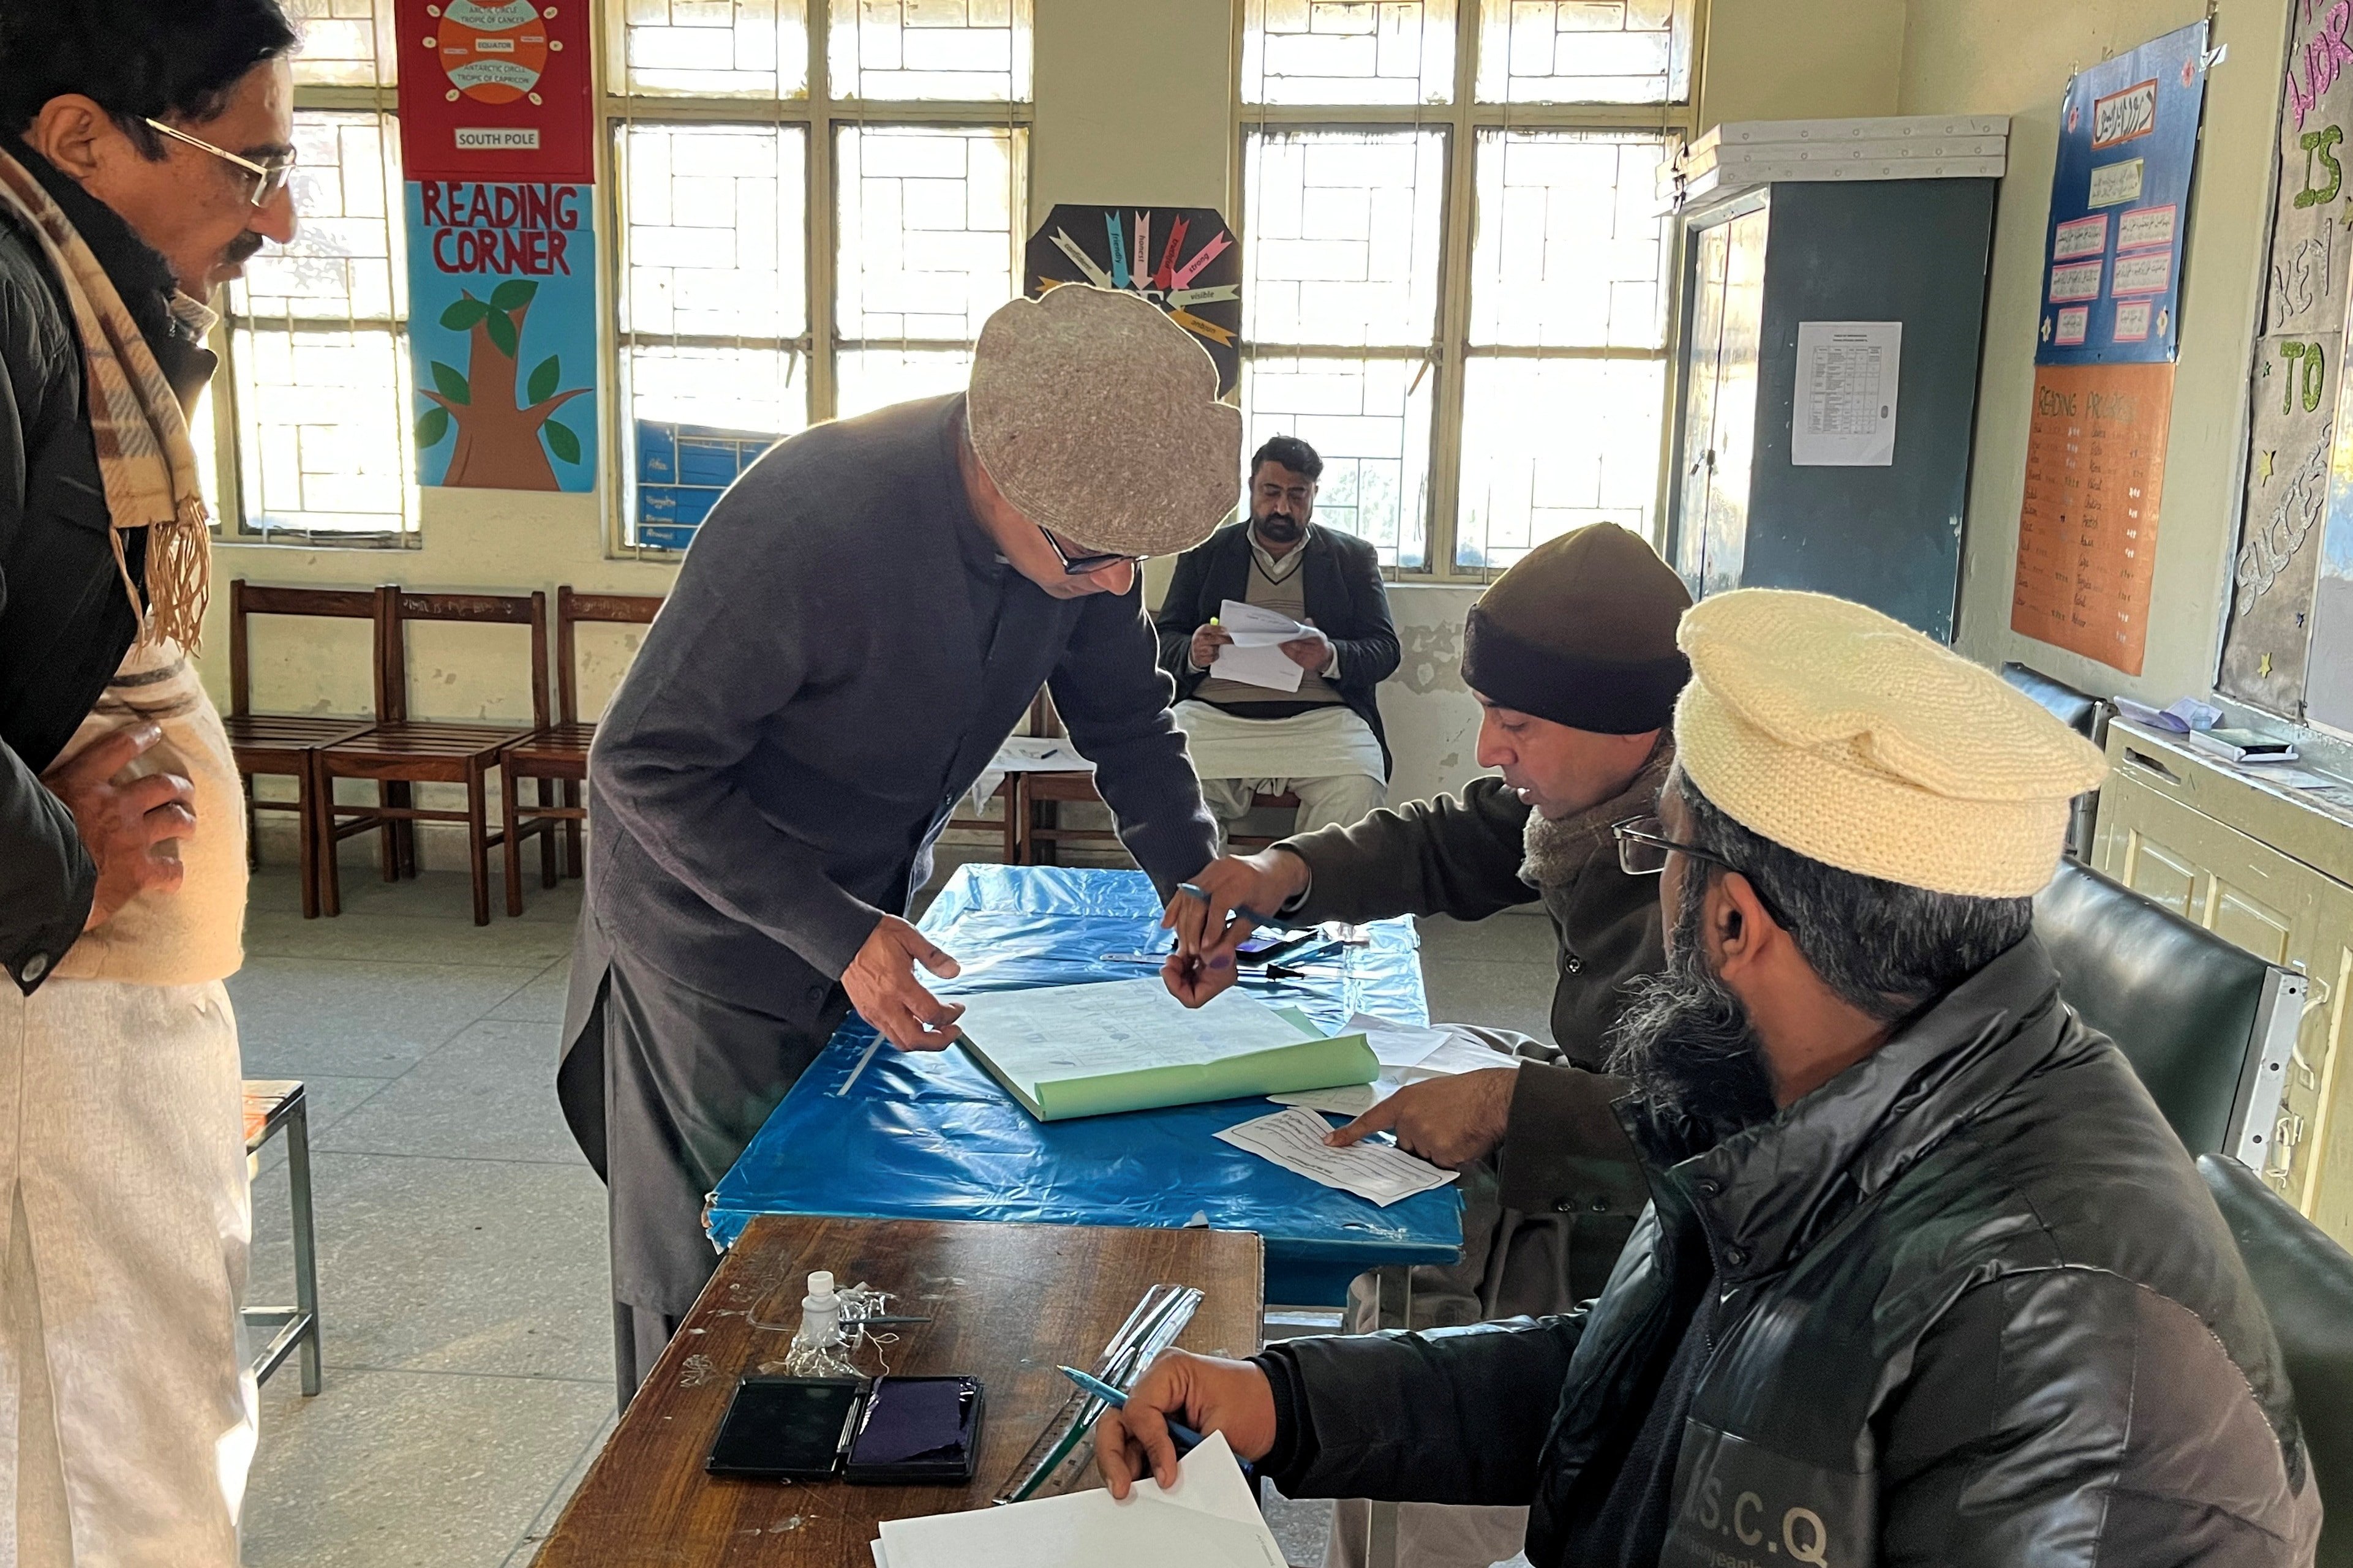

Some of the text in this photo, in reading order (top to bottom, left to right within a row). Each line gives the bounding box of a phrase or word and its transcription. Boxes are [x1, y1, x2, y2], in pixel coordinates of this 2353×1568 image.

[2287, 0, 2353, 132] WOR
[459, 133, 535, 144] SOUTH POLE
[2293, 124, 2343, 209] IS
[421, 181, 578, 231] READING
[433, 228, 571, 275] CORNER
[1064, 243, 1093, 271] confident
[1110, 233, 1123, 264] friendly
[1165, 238, 1180, 270] truthful
[1188, 252, 1210, 273] strong
[1190, 290, 1214, 300] visible
[2280, 341, 2324, 415] TO
[2039, 386, 2077, 417] READING
